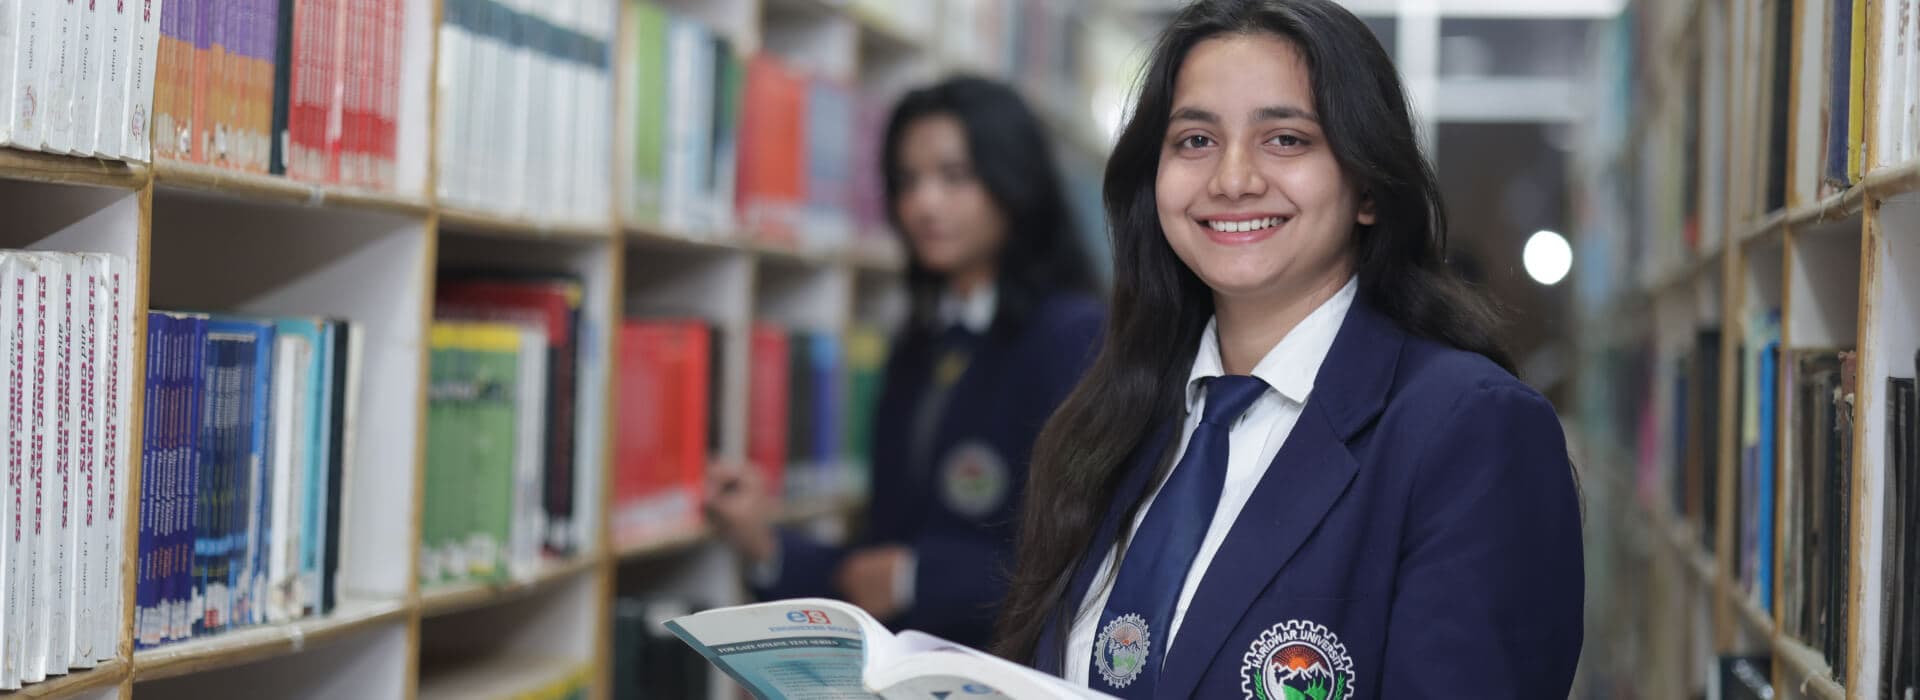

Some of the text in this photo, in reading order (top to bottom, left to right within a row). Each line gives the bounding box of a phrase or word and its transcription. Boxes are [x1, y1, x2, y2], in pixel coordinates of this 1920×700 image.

[35, 275, 46, 535] ELECTRONIC DEVICES
[64, 272, 72, 421] ELECTRONIC
[86, 275, 95, 528] ELECTRONIC DEVICES
[108, 272, 119, 520] ELECTRONIC DEVICES
[1252, 630, 1346, 671] HARIDWAR UNIVERSITY
